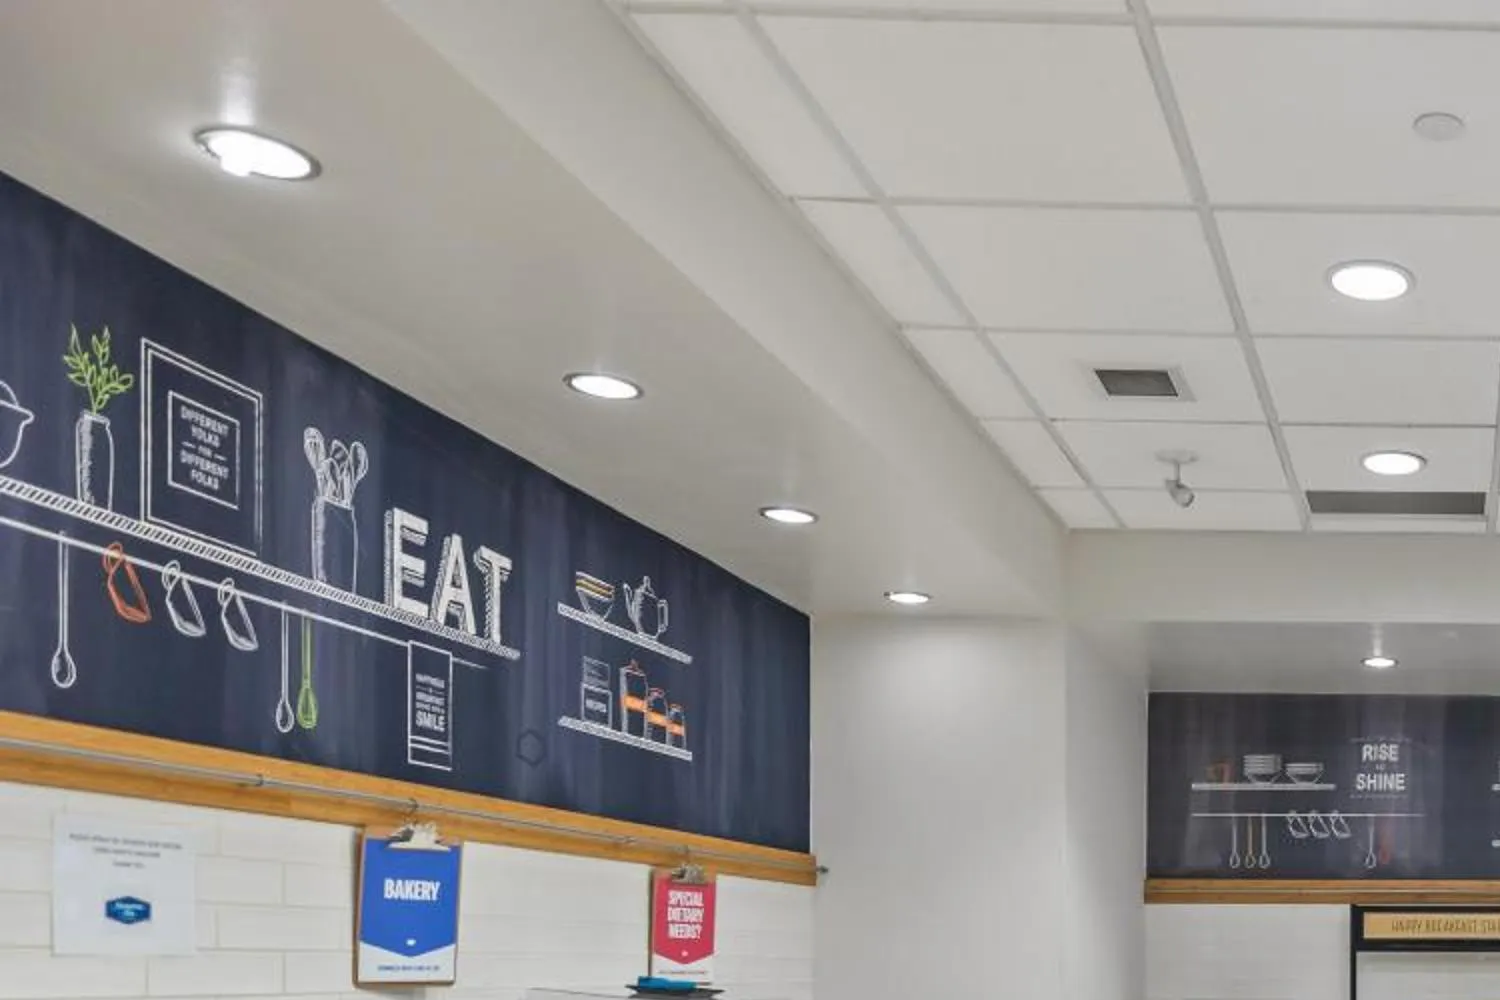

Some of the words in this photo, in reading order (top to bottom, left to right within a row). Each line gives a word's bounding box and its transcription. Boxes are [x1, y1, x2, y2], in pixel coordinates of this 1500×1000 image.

[181, 404, 229, 437] DIFFERENT
[180, 448, 229, 480] DIFFERENT
[384, 507, 513, 643] EAT
[415, 710, 445, 732] SMILE
[1362, 743, 1399, 762] RISE
[1356, 773, 1405, 792] SHINE
[383, 877, 441, 901] BAKERY
[668, 889, 704, 907] SPECIAL
[667, 907, 705, 923] DIETARY
[668, 923, 702, 940] NEEDS?
[1425, 919, 1477, 933] BREAKFAST
